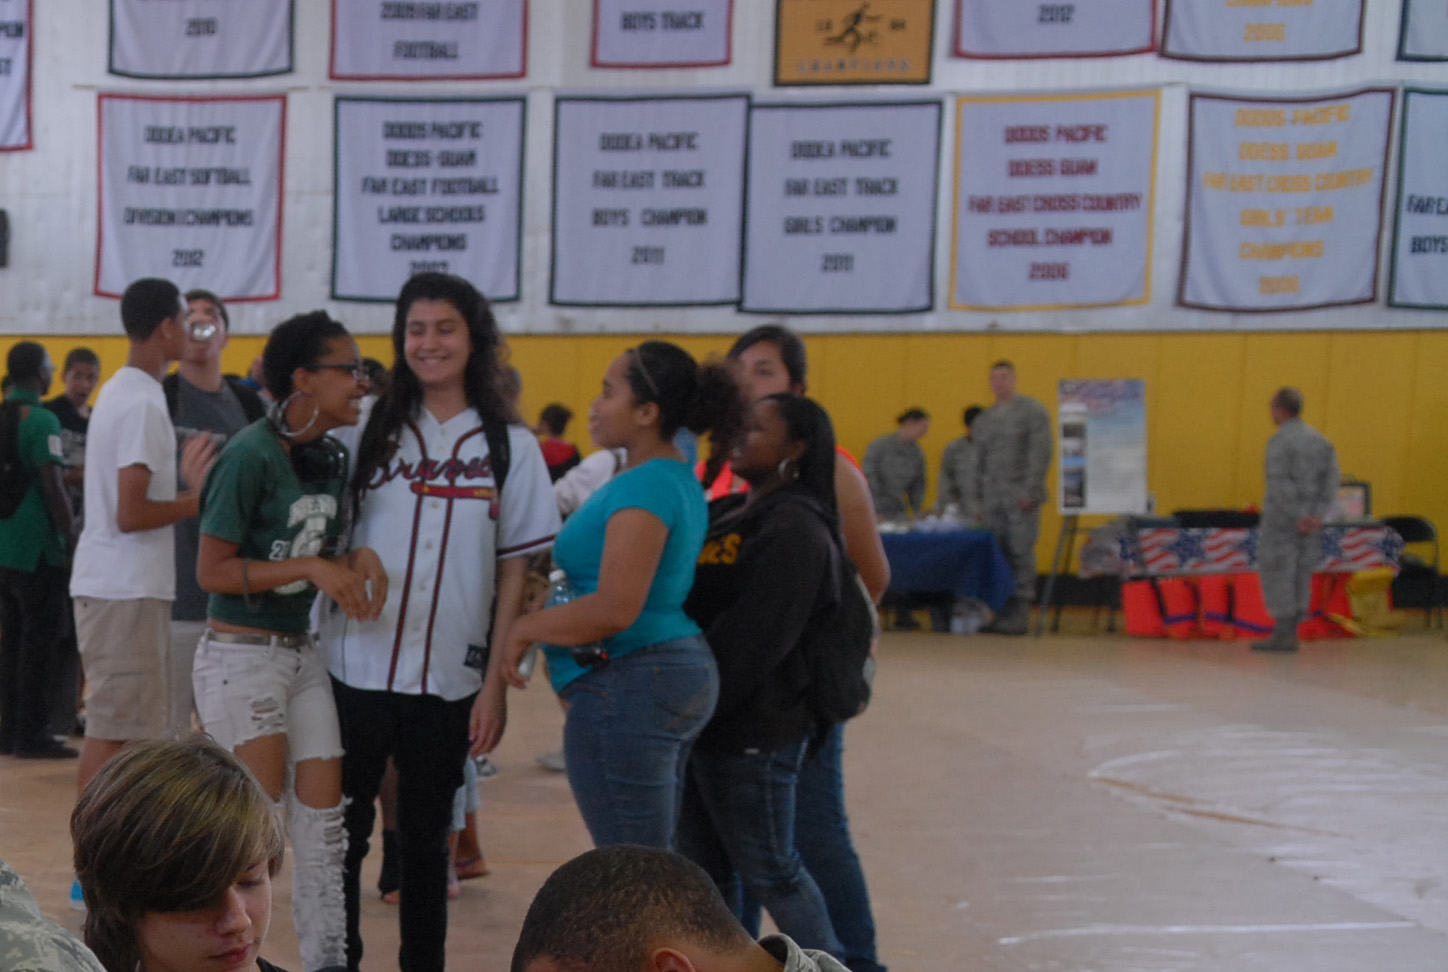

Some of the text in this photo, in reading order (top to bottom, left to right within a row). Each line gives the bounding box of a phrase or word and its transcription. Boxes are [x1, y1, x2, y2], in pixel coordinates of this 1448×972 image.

[620, 11, 704, 30] BOYS TRACK
[393, 41, 458, 59] FOOTBALL
[648, 131, 699, 150] PACIFIC
[1056, 124, 1109, 142] PACIFIC
[840, 139, 892, 158] PACIFIC
[361, 176, 499, 195] FAR EAST FOOTBALL
[593, 170, 705, 189] FAR EAST TRACK
[784, 177, 899, 196] FAR EAST TRACK
[1203, 168, 1373, 192] FAR EAST CROSS COUNTRY
[968, 193, 1143, 213] FAR EAST CROSS COUNTRY
[1407, 195, 1435, 214] FAR
[592, 208, 707, 226] BOYS CHAMPION
[783, 215, 898, 234] GIRLS CHAMPION
[1296, 206, 1334, 225] TEAM
[390, 233, 467, 251] CHAMPIONS
[987, 228, 1113, 247] SCHOOL CHAMPION
[1239, 240, 1324, 260] CHAMPIONS
